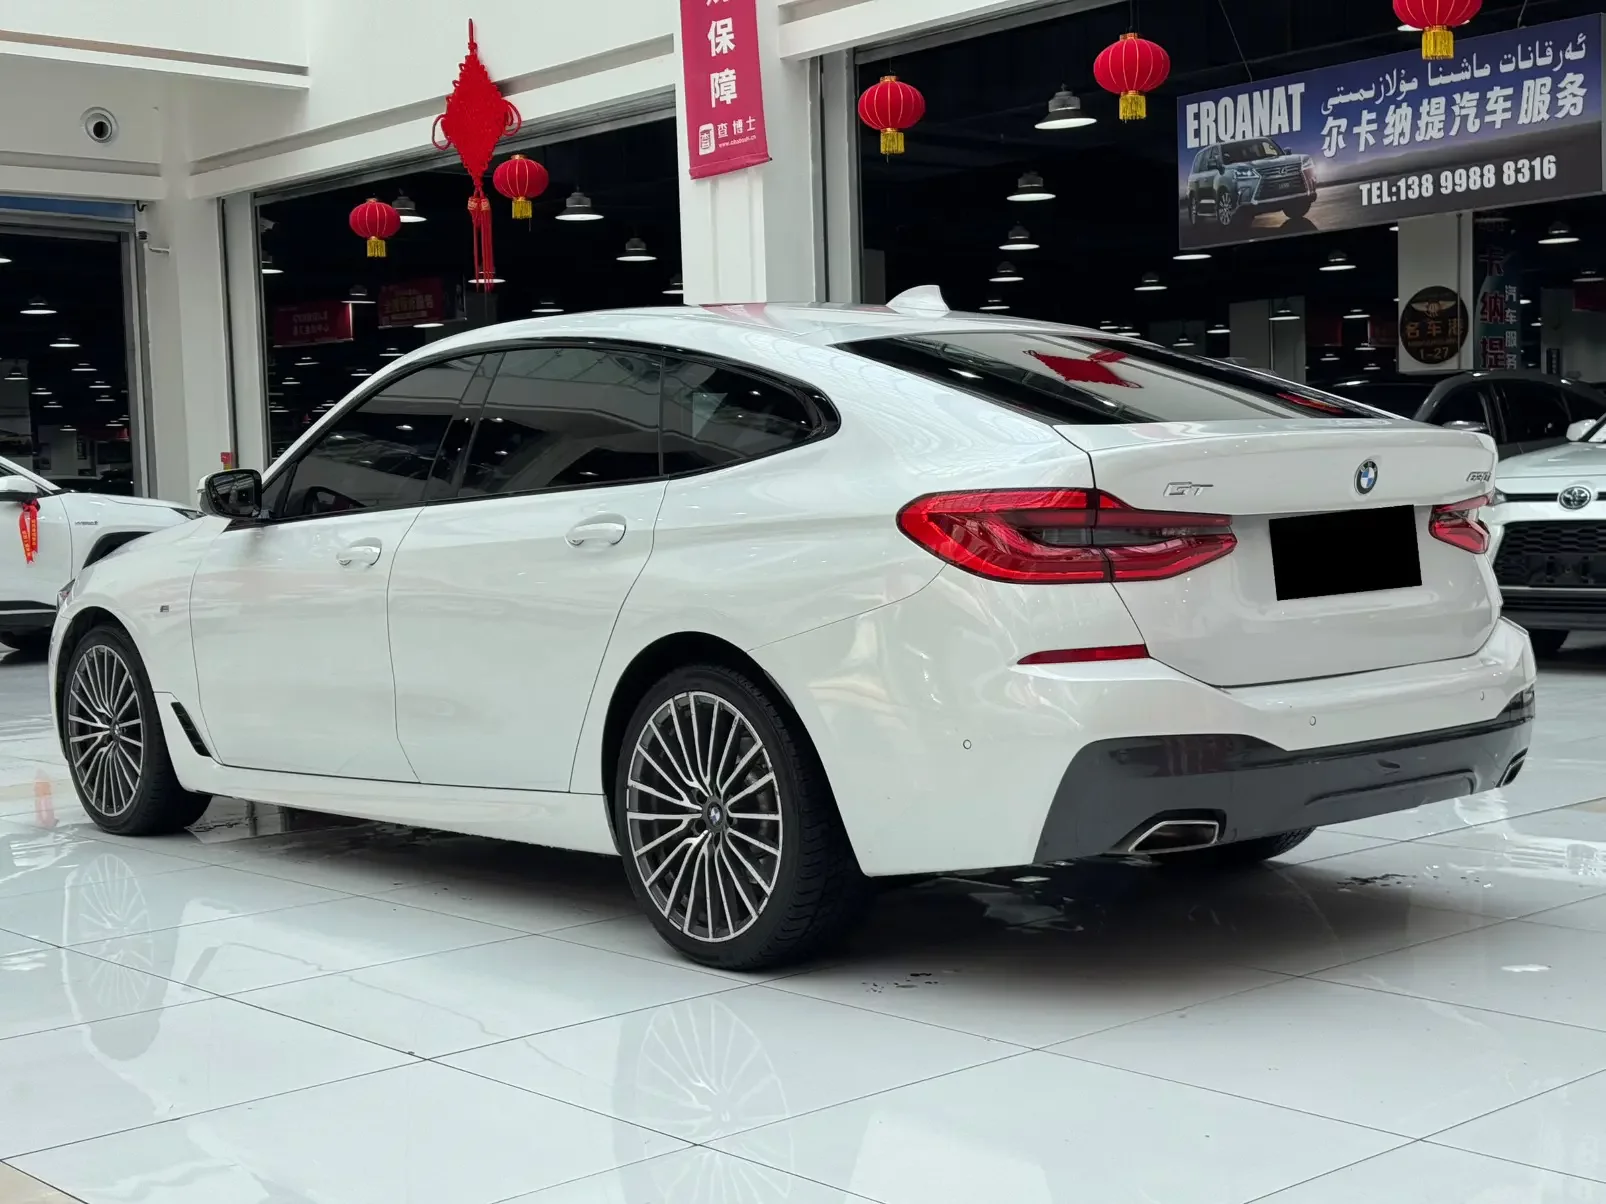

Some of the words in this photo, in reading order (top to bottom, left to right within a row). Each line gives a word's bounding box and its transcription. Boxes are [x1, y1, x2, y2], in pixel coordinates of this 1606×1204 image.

[706, 0, 737, 108] 保障
[717, 116, 757, 139] 查博士
[1186, 82, 1305, 149] ERQANAT
[1321, 73, 1588, 158] 尔卡纳提汽车服务
[1360, 173, 1434, 206] TEL:138
[1440, 164, 1496, 195] 9988
[1502, 155, 1557, 186] 8316
[1420, 347, 1449, 360] 1-27
[1163, 481, 1214, 497] GT
